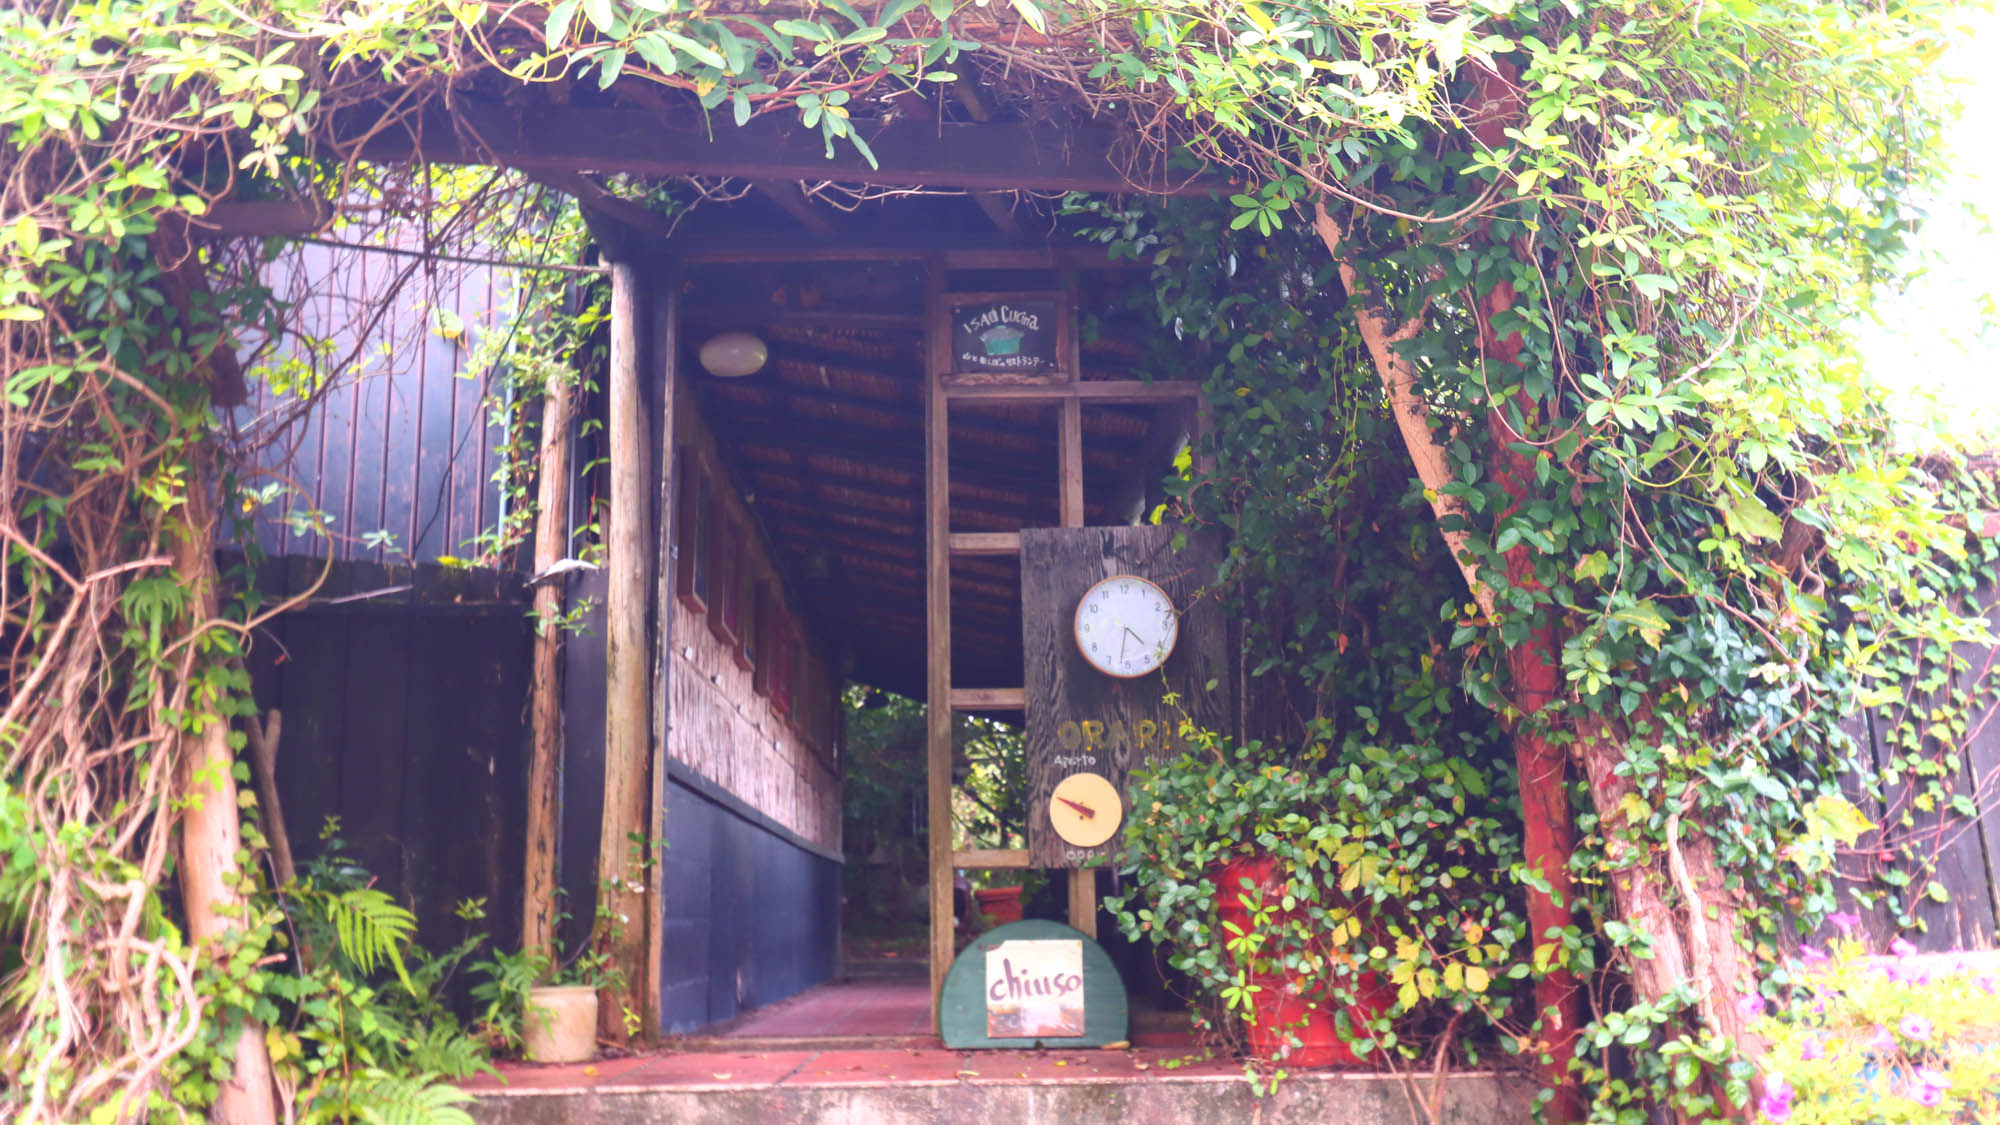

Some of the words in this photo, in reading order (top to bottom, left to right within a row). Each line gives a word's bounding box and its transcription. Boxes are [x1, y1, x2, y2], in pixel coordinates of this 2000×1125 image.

[1119, 584, 1129, 595] 12
[1102, 590, 1109, 600] 11
[1089, 603, 1098, 614] 10
[1155, 602, 1161, 612] 2
[1084, 623, 1090, 633] 9
[1091, 642, 1098, 652] 8
[1106, 655, 1112, 665] 7
[1143, 654, 1151, 665] 5
[1057, 719, 1193, 750] ORARI
[990, 958, 1082, 1001] chiuso
